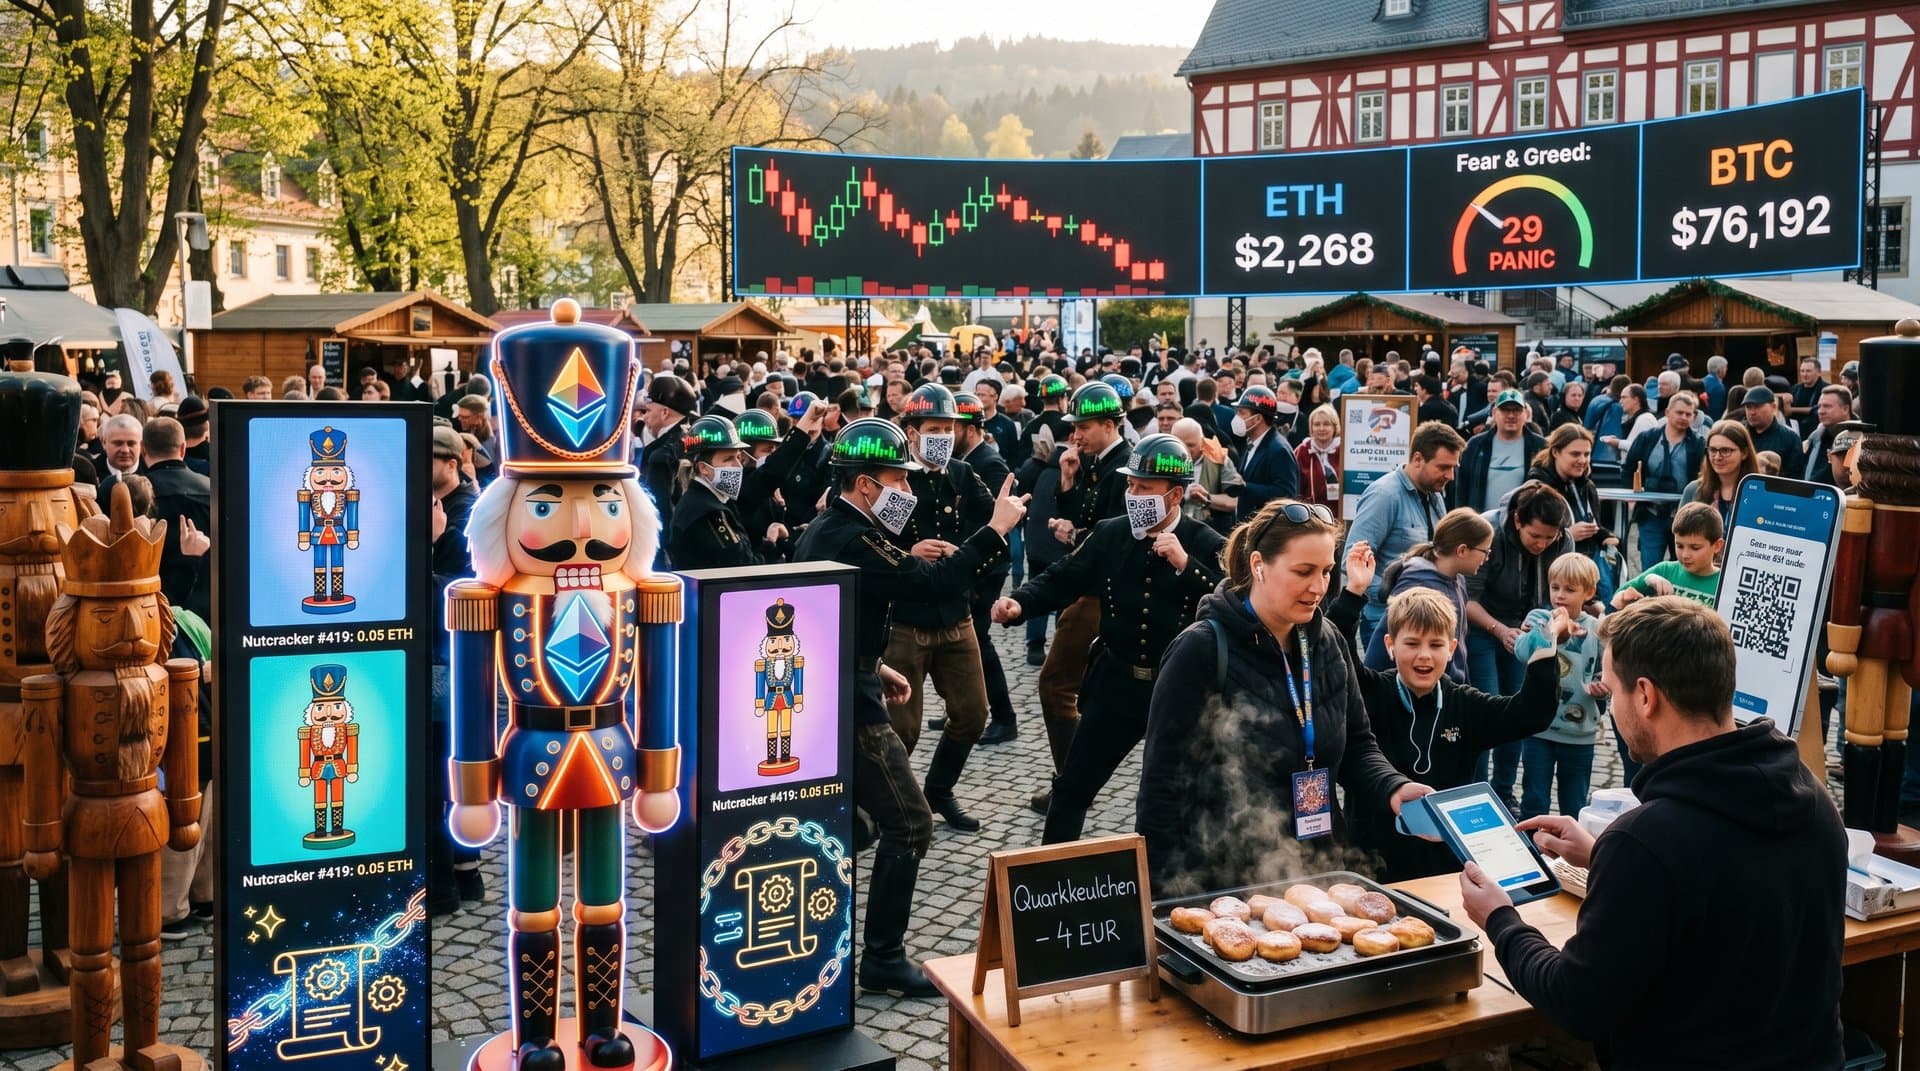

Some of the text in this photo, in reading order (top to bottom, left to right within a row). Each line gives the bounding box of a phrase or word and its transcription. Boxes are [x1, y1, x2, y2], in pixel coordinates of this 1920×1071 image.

[1456, 141, 1592, 172] Fear & Greed:
[1710, 139, 1794, 186] BTC
[1266, 183, 1344, 217] ETH
[1502, 215, 1543, 244] 29
[1671, 195, 1831, 250] $76,192
[1235, 232, 1375, 274] $2,268
[1489, 249, 1556, 271] PANIC
[242, 628, 414, 648] Nutcracker #419: 0.05 ETH
[712, 782, 844, 812] Nutcracker #419: 0.05 ETH
[242, 859, 414, 887] Nutcracker #419: 0.05 ETH
[1014, 874, 1137, 912] Quarkkeulchen
[1056, 920, 1073, 949] 4
[1080, 919, 1121, 946] EUR
